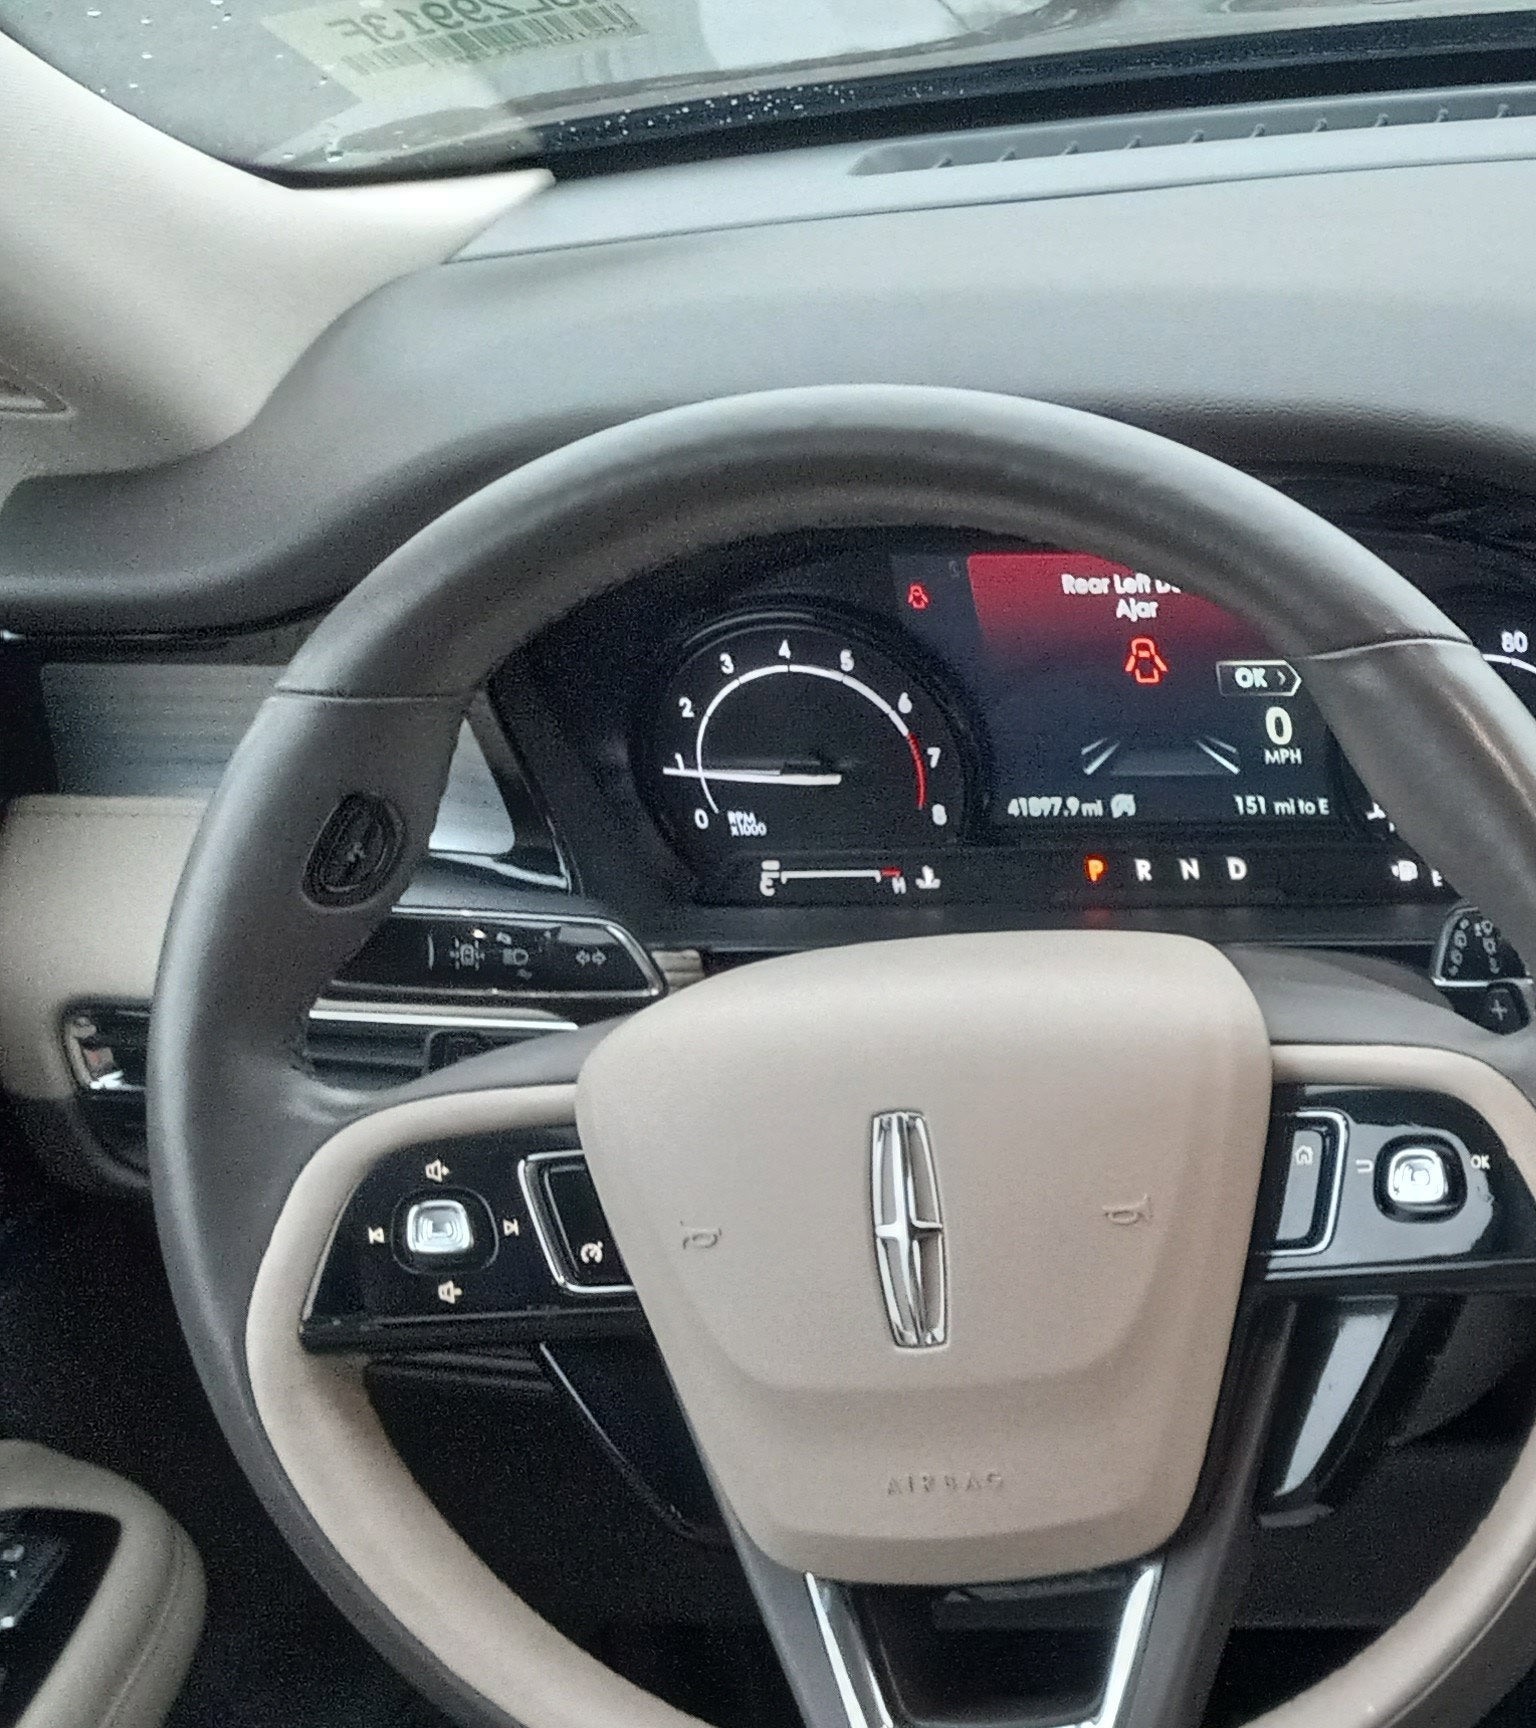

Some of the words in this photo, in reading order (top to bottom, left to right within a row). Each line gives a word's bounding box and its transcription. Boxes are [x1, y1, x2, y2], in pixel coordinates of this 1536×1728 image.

[1061, 573, 1110, 595] Rear
[1113, 572, 1151, 594] Left
[1116, 597, 1159, 622] Ajar
[778, 639, 791, 661] 4
[1501, 631, 1527, 653] 80
[719, 652, 735, 675] 3
[840, 650, 855, 672] 5
[1234, 667, 1268, 689] OK
[679, 697, 695, 719] 2
[898, 692, 913, 714] 6
[1265, 706, 1293, 745] 0
[926, 747, 941, 769] 7
[1264, 749, 1302, 766] MPH
[1233, 795, 1267, 816] 151
[1273, 797, 1296, 816] mi
[1298, 798, 1315, 815] to
[1318, 798, 1330, 815] E
[694, 809, 708, 830] 0
[727, 810, 756, 825] RPM
[1086, 857, 1104, 883] P
[1134, 857, 1153, 882] R
[1177, 857, 1200, 881] N
[1226, 856, 1248, 881] D
[1470, 1154, 1492, 1171] OK
